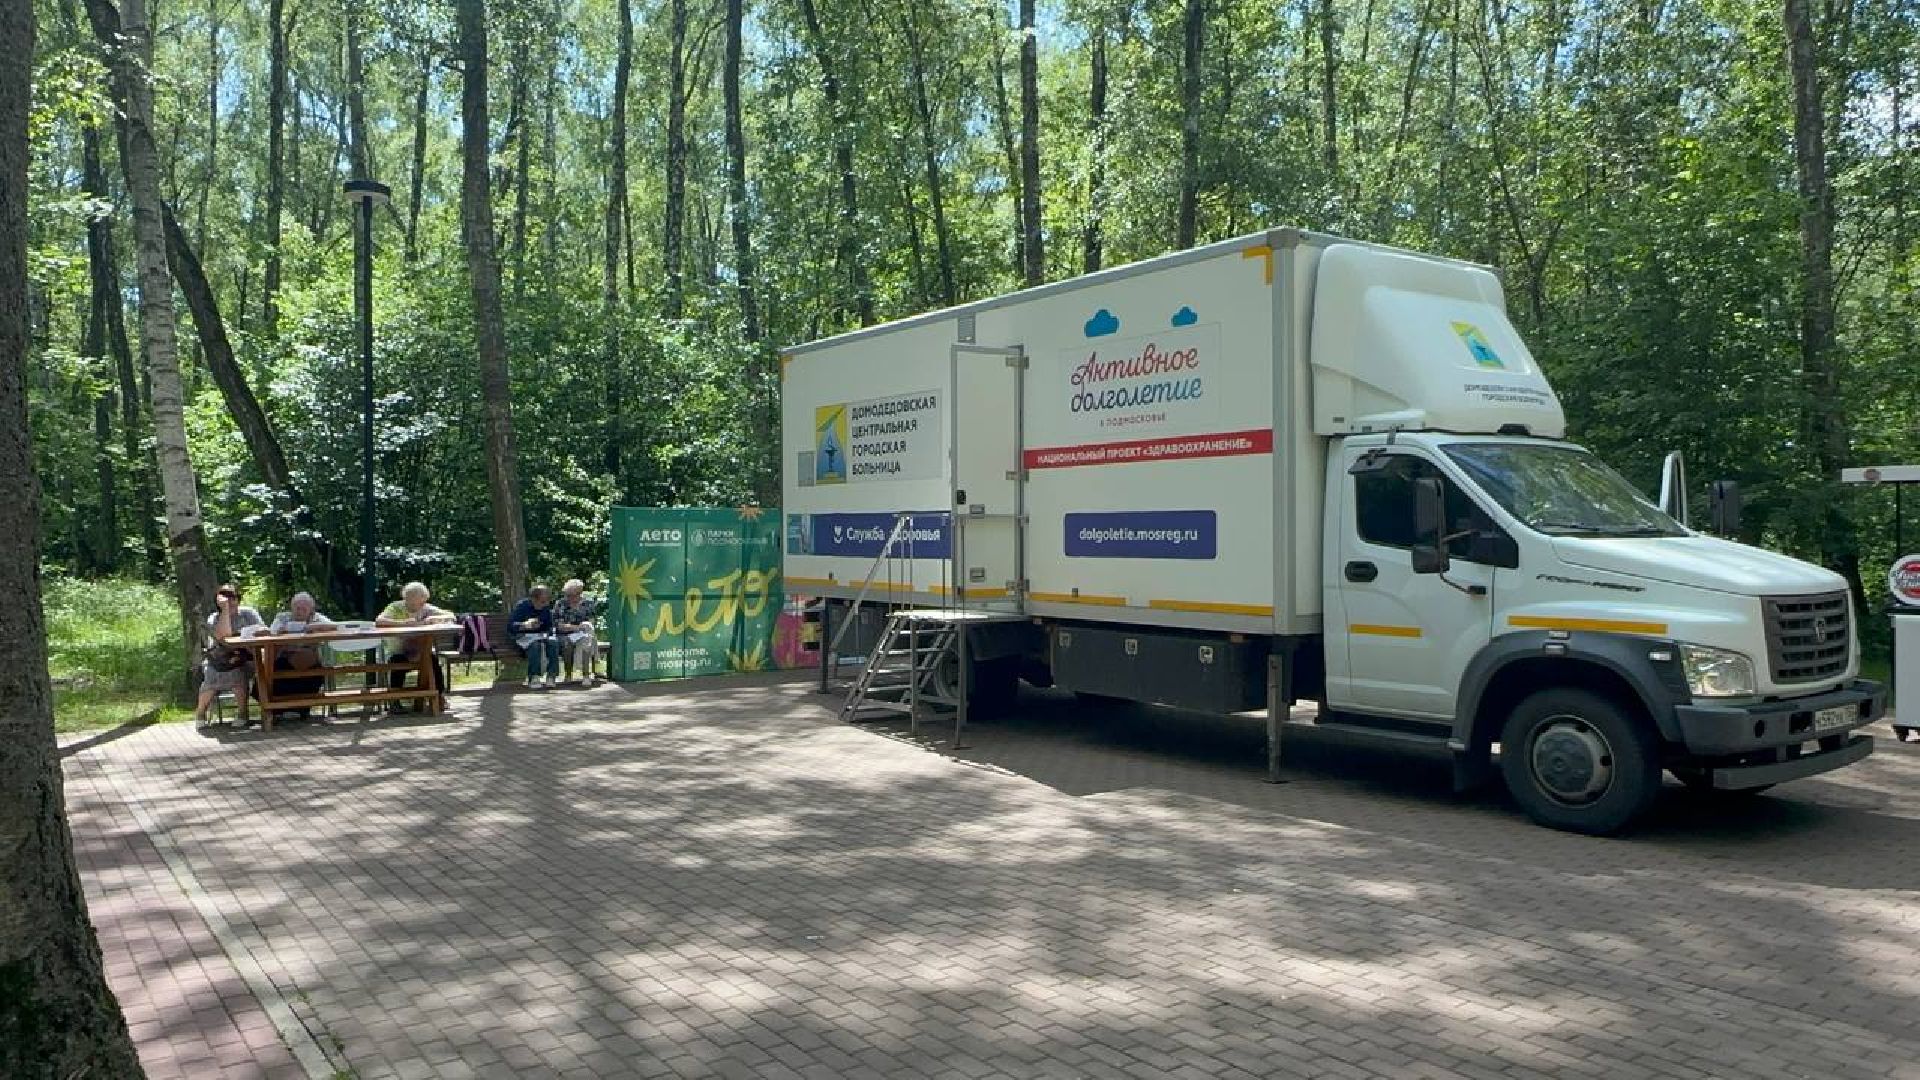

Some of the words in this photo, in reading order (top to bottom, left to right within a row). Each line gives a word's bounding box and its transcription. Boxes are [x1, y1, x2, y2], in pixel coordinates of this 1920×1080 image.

[1071, 343, 1199, 385] Активное
[1071, 378, 1201, 412] долголетие
[852, 396, 936, 420] ДОМОДЕДОВСКАЯ
[852, 419, 917, 439] ЦЕНТРАЛЬНАЯ
[852, 440, 906, 457] ГОРОДСКАЯ
[1037, 448, 1105, 464] НАЦИОНАЛЬНЫЙ
[1107, 447, 1141, 458] ПРОЕКТ
[1143, 438, 1252, 457] «ЗДРАВООХРАНЕНИЕ»
[852, 460, 900, 475] БОЛЬНИЦА
[846, 526, 885, 543] Служба
[1079, 527, 1198, 544] dolgoletie.mosreg.ru
[656, 648, 709, 658] welcome.
[656, 657, 712, 670] mosreg.ru
